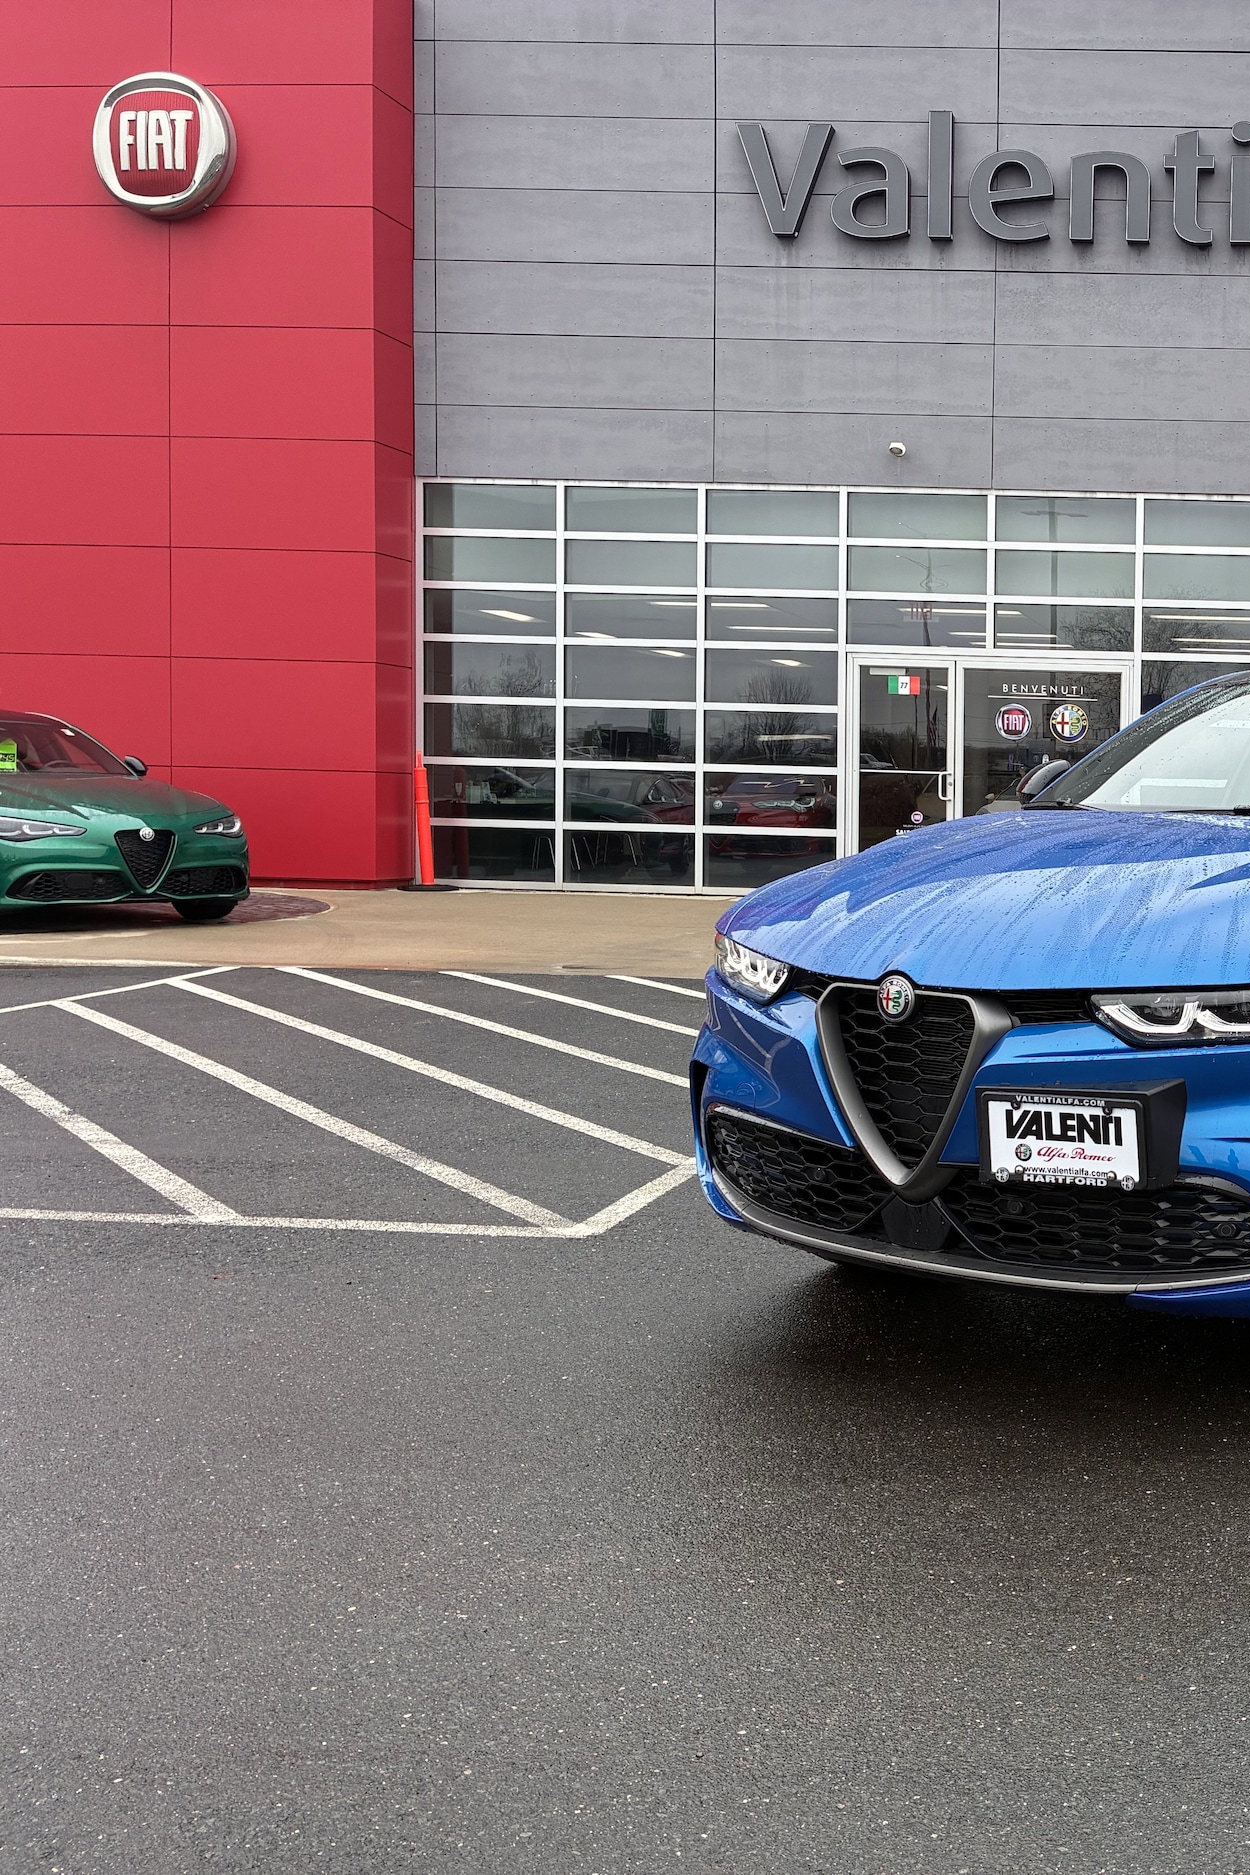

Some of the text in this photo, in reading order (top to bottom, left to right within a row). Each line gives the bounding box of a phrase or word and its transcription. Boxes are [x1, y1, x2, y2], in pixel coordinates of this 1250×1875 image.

[120, 110, 194, 171] FIAT
[1003, 683, 1084, 696] BENVENUTI
[1003, 714, 1025, 731] FIAT
[1015, 1095, 1105, 1107] VALENTIALFA.COM
[1005, 1109, 1123, 1146] VALENTI
[1037, 1144, 1069, 1162] Alfa
[1070, 1147, 1116, 1162] Romeo
[1024, 1166, 1109, 1178] www.valentialfa.com
[1023, 1173, 1107, 1187] HARTFORD
